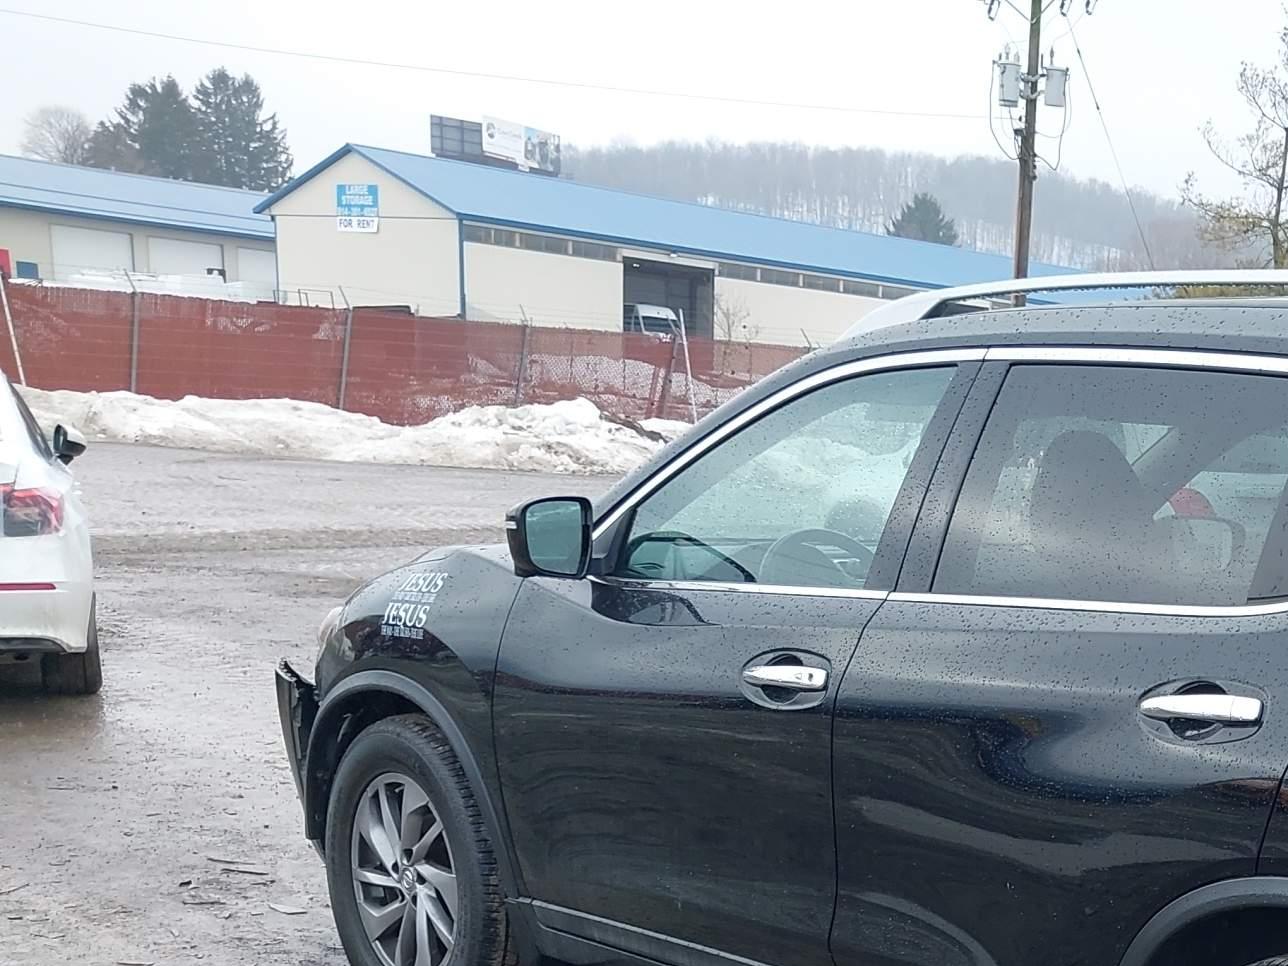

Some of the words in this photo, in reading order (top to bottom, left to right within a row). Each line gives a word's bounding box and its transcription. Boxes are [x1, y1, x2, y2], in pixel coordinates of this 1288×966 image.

[339, 218, 353, 229] FOR
[357, 218, 375, 229] RENT
[398, 572, 448, 593] JESUS
[382, 602, 430, 628] JESUS
